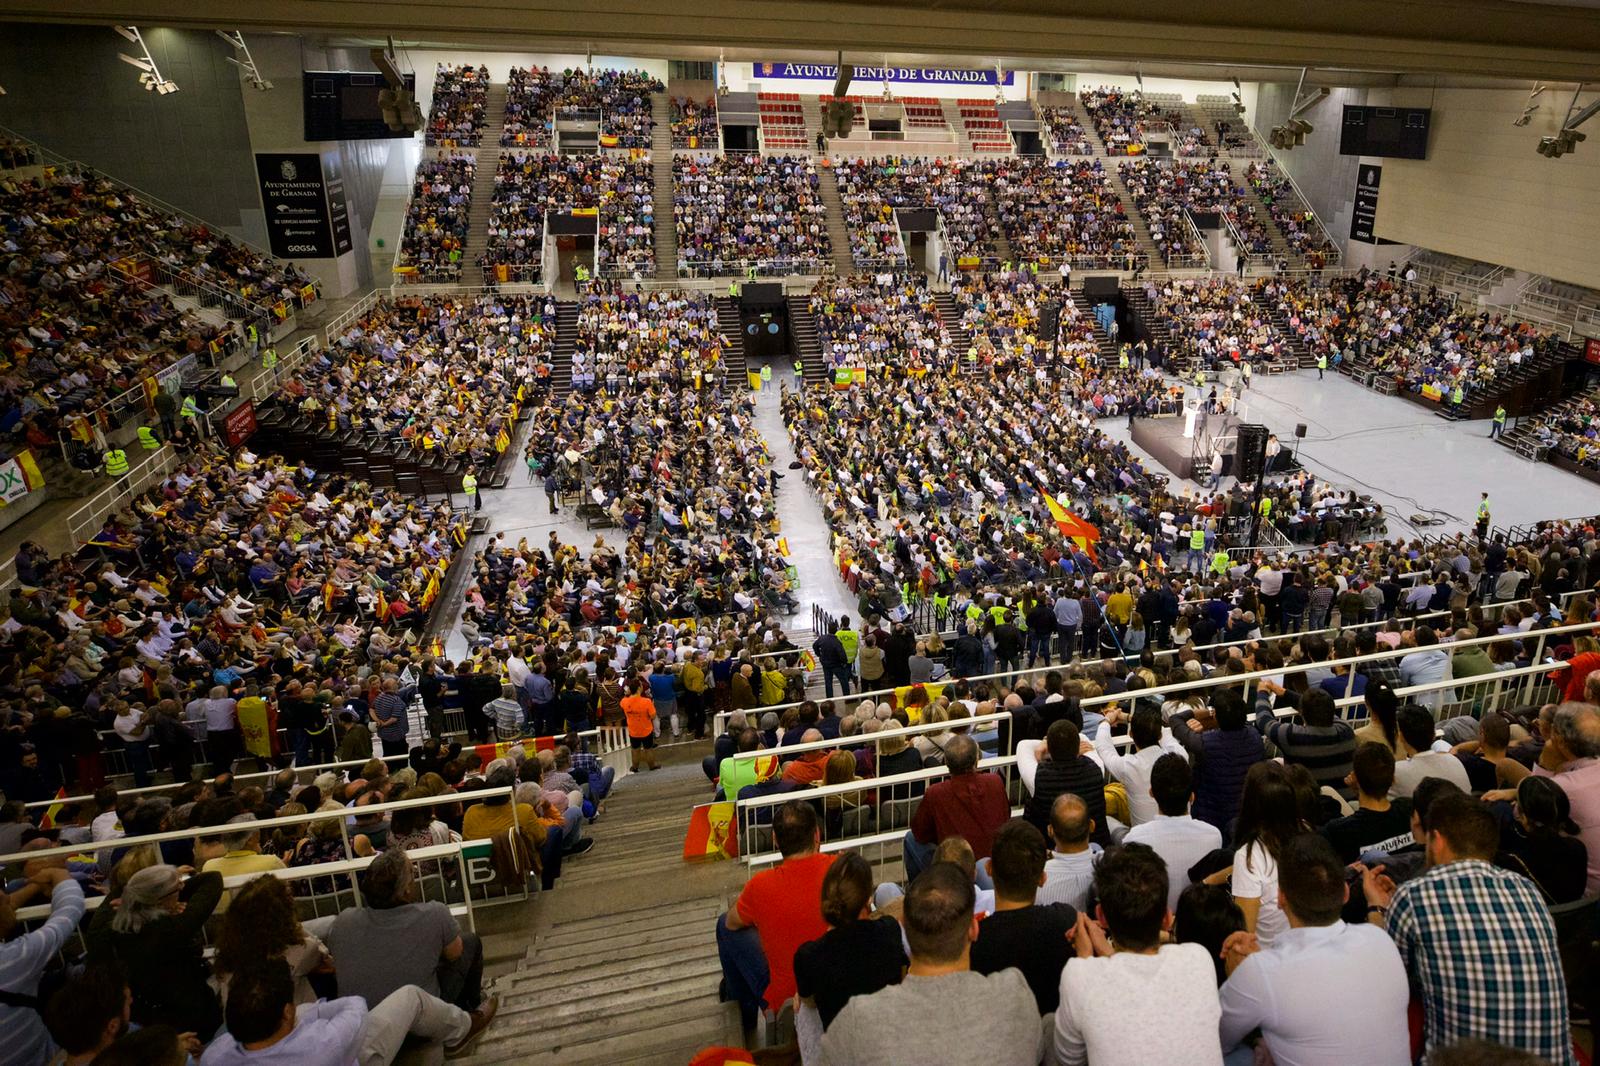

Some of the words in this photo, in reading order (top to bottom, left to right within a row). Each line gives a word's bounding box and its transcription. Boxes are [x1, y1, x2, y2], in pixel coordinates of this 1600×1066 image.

[784, 63, 895, 79] AYUNTAIENTO
[900, 69, 917, 80] DE
[922, 69, 987, 82] GRANADA
[281, 189, 317, 197] GRANADA
[467, 857, 496, 884] B
